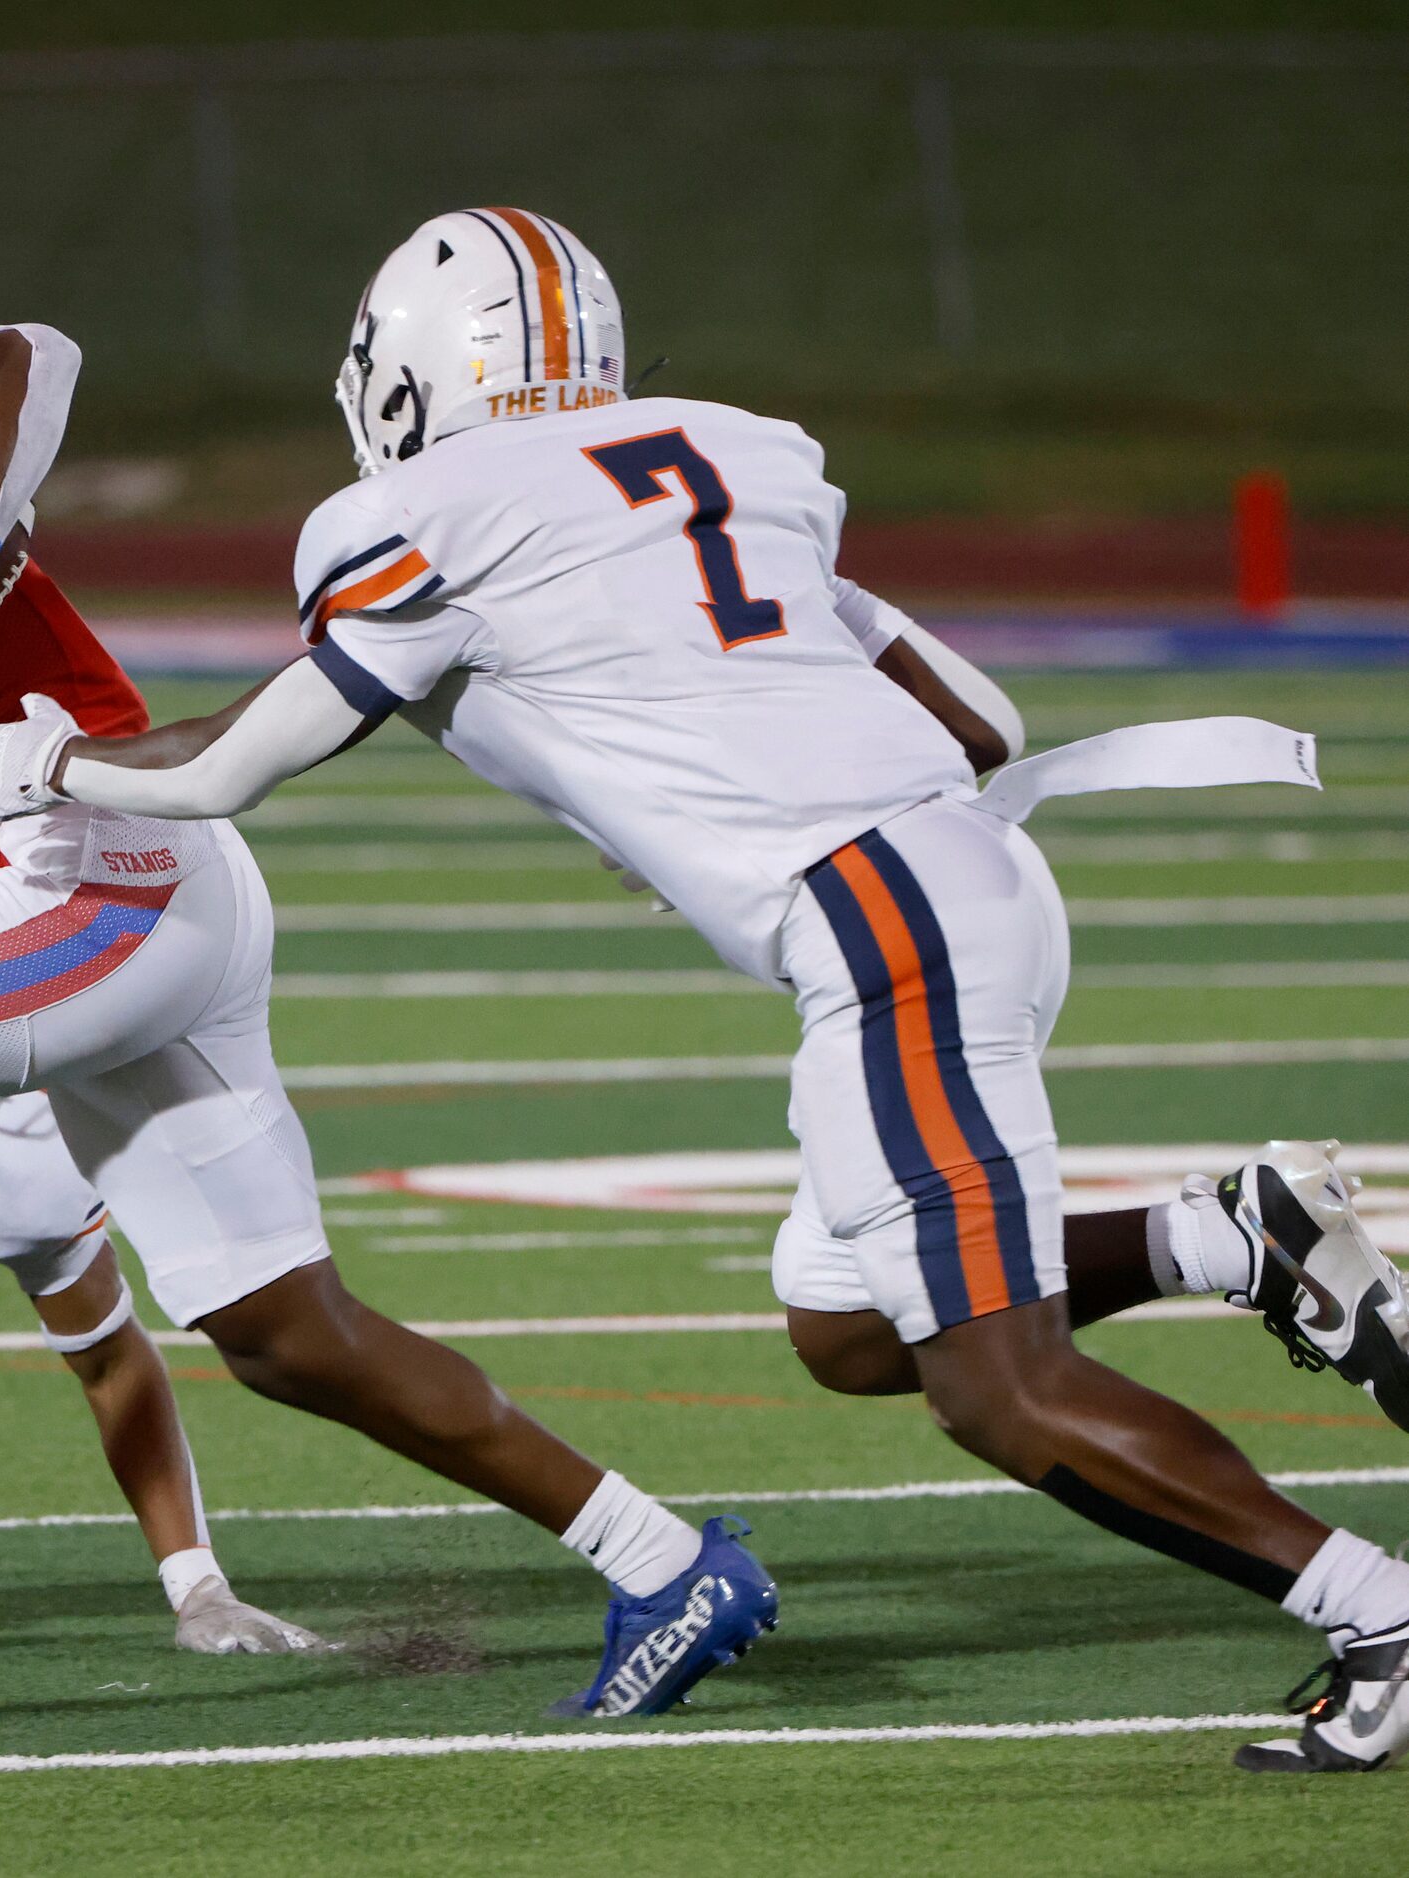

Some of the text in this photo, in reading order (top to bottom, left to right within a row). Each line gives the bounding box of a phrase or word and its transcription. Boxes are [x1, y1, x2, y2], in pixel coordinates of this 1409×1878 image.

[486, 384, 618, 418] THE LAND
[579, 426, 788, 652] 7
[101, 847, 178, 874] STANGS
